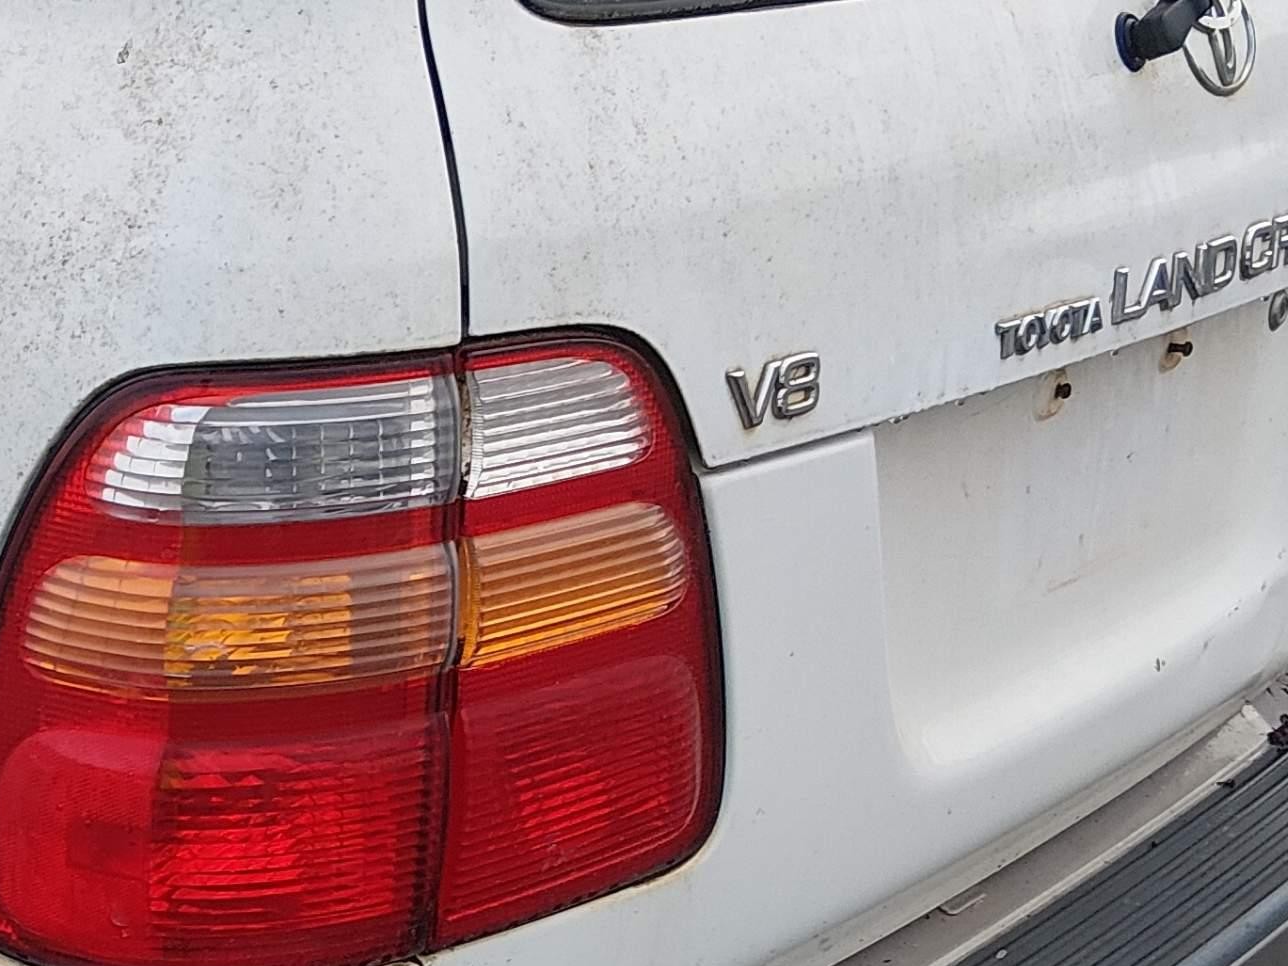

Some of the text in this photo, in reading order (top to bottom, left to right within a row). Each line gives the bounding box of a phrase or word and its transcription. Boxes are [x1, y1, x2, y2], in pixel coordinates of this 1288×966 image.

[995, 297, 1102, 360] TOYOTA
[1110, 234, 1237, 325] LAND
[725, 351, 820, 429] V8
